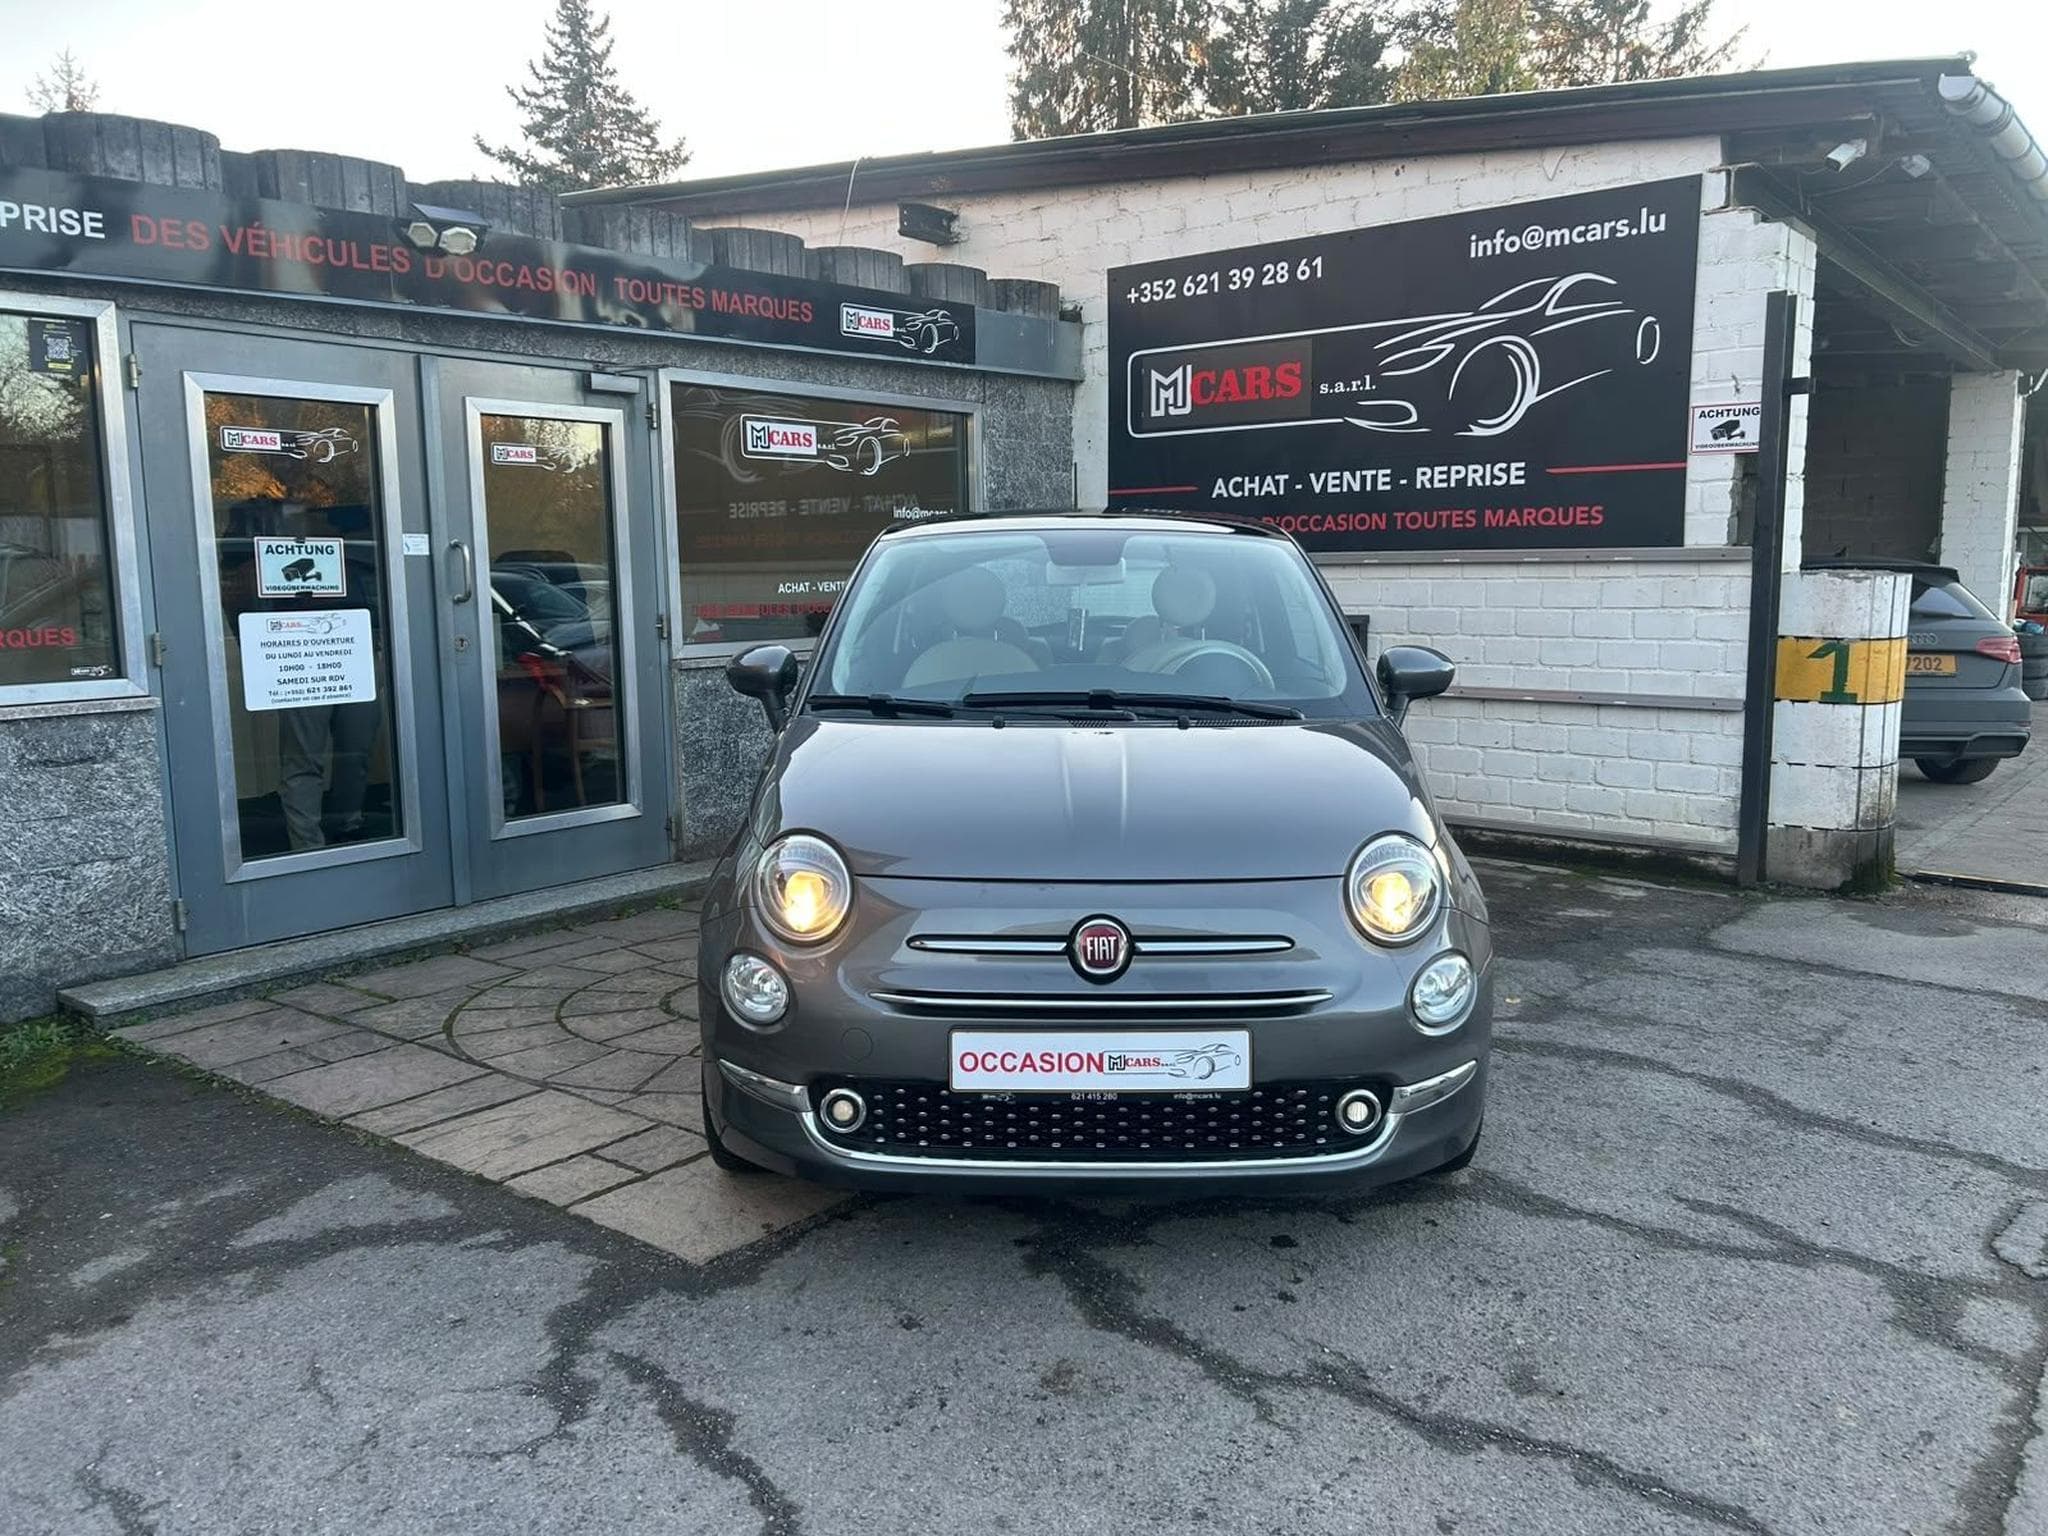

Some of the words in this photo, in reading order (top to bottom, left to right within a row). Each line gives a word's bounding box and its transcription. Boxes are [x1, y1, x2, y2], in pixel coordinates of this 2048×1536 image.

[1470, 207, 1666, 259] info@mcars.lu
[0, 201, 105, 239] PRISE
[131, 214, 210, 252] DES
[220, 222, 410, 273] VÉHICULES
[425, 255, 596, 298] DOCCASION
[614, 277, 705, 310] TOUTES
[711, 290, 813, 323] MARQUES
[1127, 278, 1177, 304] +352
[1183, 271, 1220, 297] 621
[1228, 266, 1255, 290] 39
[1262, 261, 1289, 285] 28
[1296, 256, 1323, 281] 61
[1319, 375, 1376, 394] s.a.r.l.
[1698, 407, 1760, 419] ACHTUNG
[1211, 474, 1289, 499] ACHAT
[1309, 469, 1392, 494] VENTE
[1416, 462, 1526, 489] REPRISE
[1394, 509, 1476, 530] TOUTES
[1484, 506, 1604, 528] MARQUES
[265, 544, 335, 555] ACHTUNG
[777, 582, 810, 594] ACHAT
[260, 640, 301, 648] HORAIRES
[303, 636, 355, 646] D'OUVERTURE
[278, 651, 301, 659] LUNDI
[316, 648, 352, 657] VENDREDI
[277, 677, 308, 686] SAMEDI
[311, 676, 327, 684] SUR
[329, 674, 345, 682] RDV
[1807, 641, 1859, 704] 1
[1086, 936, 1117, 961] FIAT
[959, 1051, 1103, 1073] OCCASION
